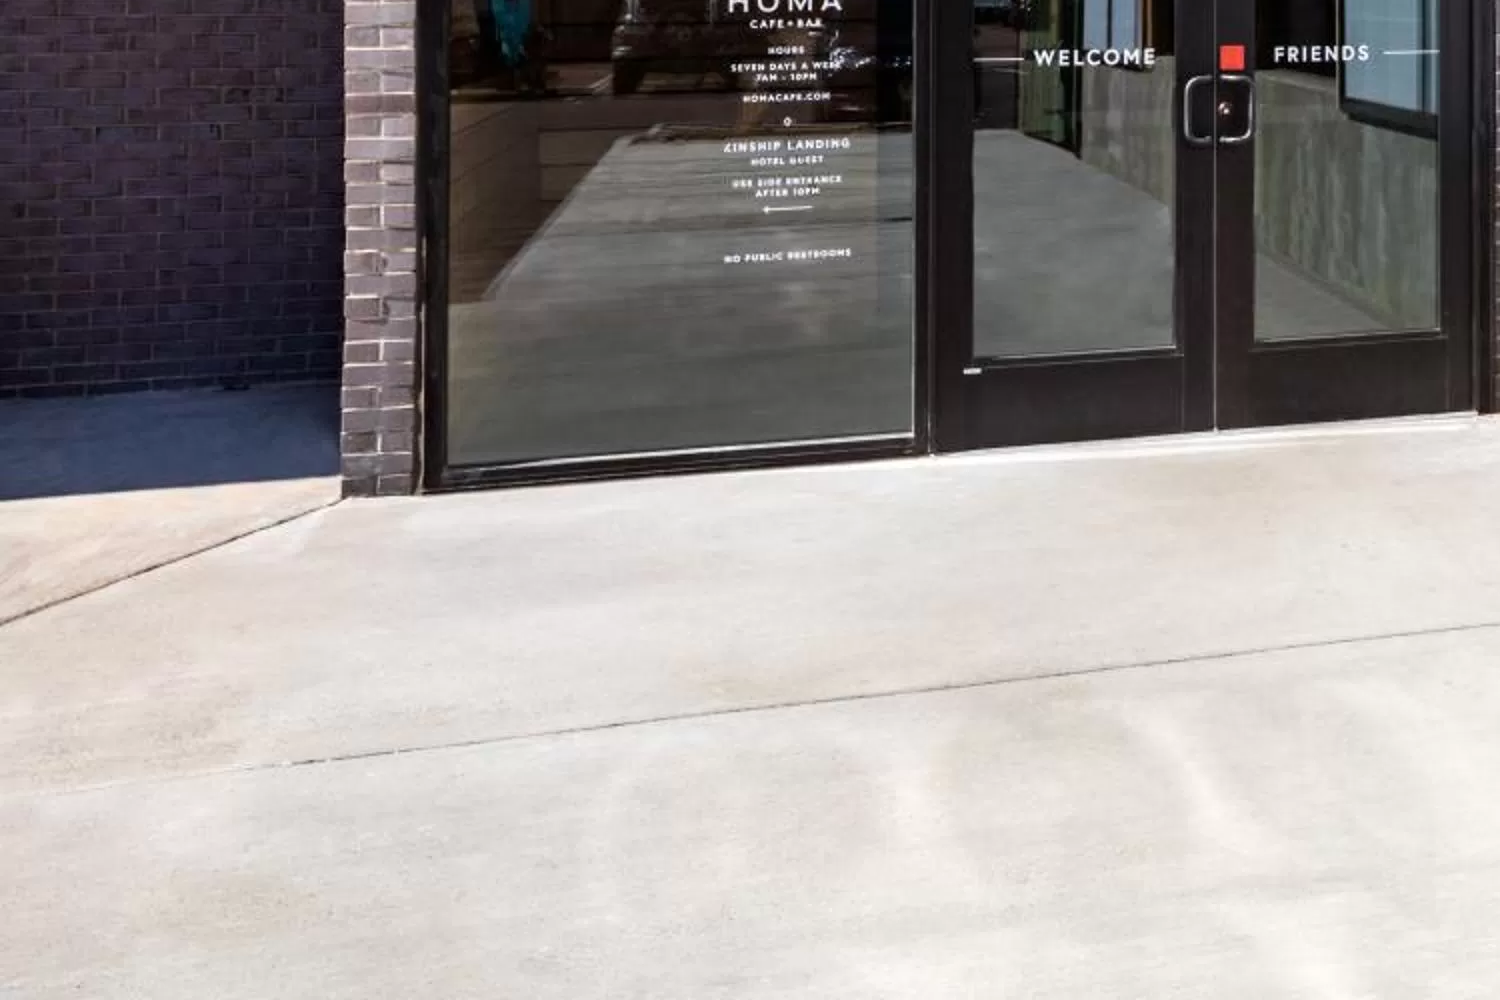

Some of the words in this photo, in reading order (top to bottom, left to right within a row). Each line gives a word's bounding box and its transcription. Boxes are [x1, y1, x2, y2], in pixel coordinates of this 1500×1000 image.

[749, 19, 784, 29] CAFE
[796, 17, 823, 29] BAR
[767, 45, 805, 55] HOURS
[1033, 48, 1157, 67] WELCOME
[1273, 45, 1370, 64] FRIENDS
[730, 63, 765, 73] SEVEN
[769, 62, 797, 71] DAYS
[801, 61, 809, 70] A
[790, 71, 818, 81] 10PM
[742, 91, 832, 103] HOMACAFE.COM
[723, 141, 782, 153] KINSHIP
[787, 137, 850, 150] LANDING
[751, 157, 786, 166] HOTEL
[789, 155, 824, 164] GUEST
[732, 179, 753, 188] USE
[757, 177, 782, 187] SIDE
[785, 175, 842, 185] ENTRANCE
[755, 188, 788, 197] AFTER
[793, 186, 821, 196] 10PM
[723, 255, 741, 264] NO
[744, 252, 783, 262] PUBLIC
[787, 248, 852, 260] RESTROOMS
